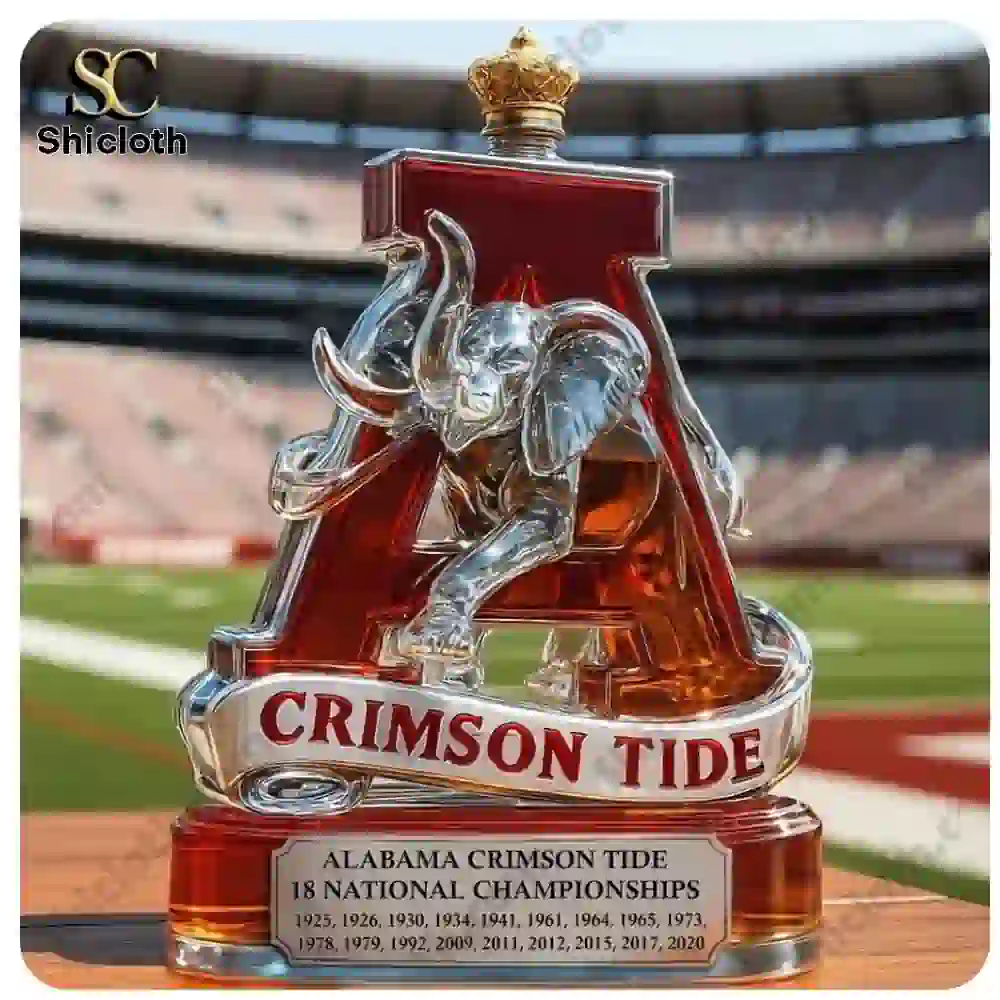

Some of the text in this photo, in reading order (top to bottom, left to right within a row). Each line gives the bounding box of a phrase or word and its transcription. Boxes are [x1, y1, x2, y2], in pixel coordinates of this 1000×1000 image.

[259, 690, 766, 790] CRIMSON TIDE
[322, 849, 669, 870] ALABAMA CRIMSON TIDE
[293, 879, 701, 900] 18 NATIONAL CHAMPIONSHIPS
[296, 912, 707, 930] 1925, 1926, 1930, 1934, 1941, 1961, 1964, 1965, 1973,
[298, 935, 706, 953] 1978, 1979, 1992, 2009, 2011, 2012, 2015, 2017, 2020
